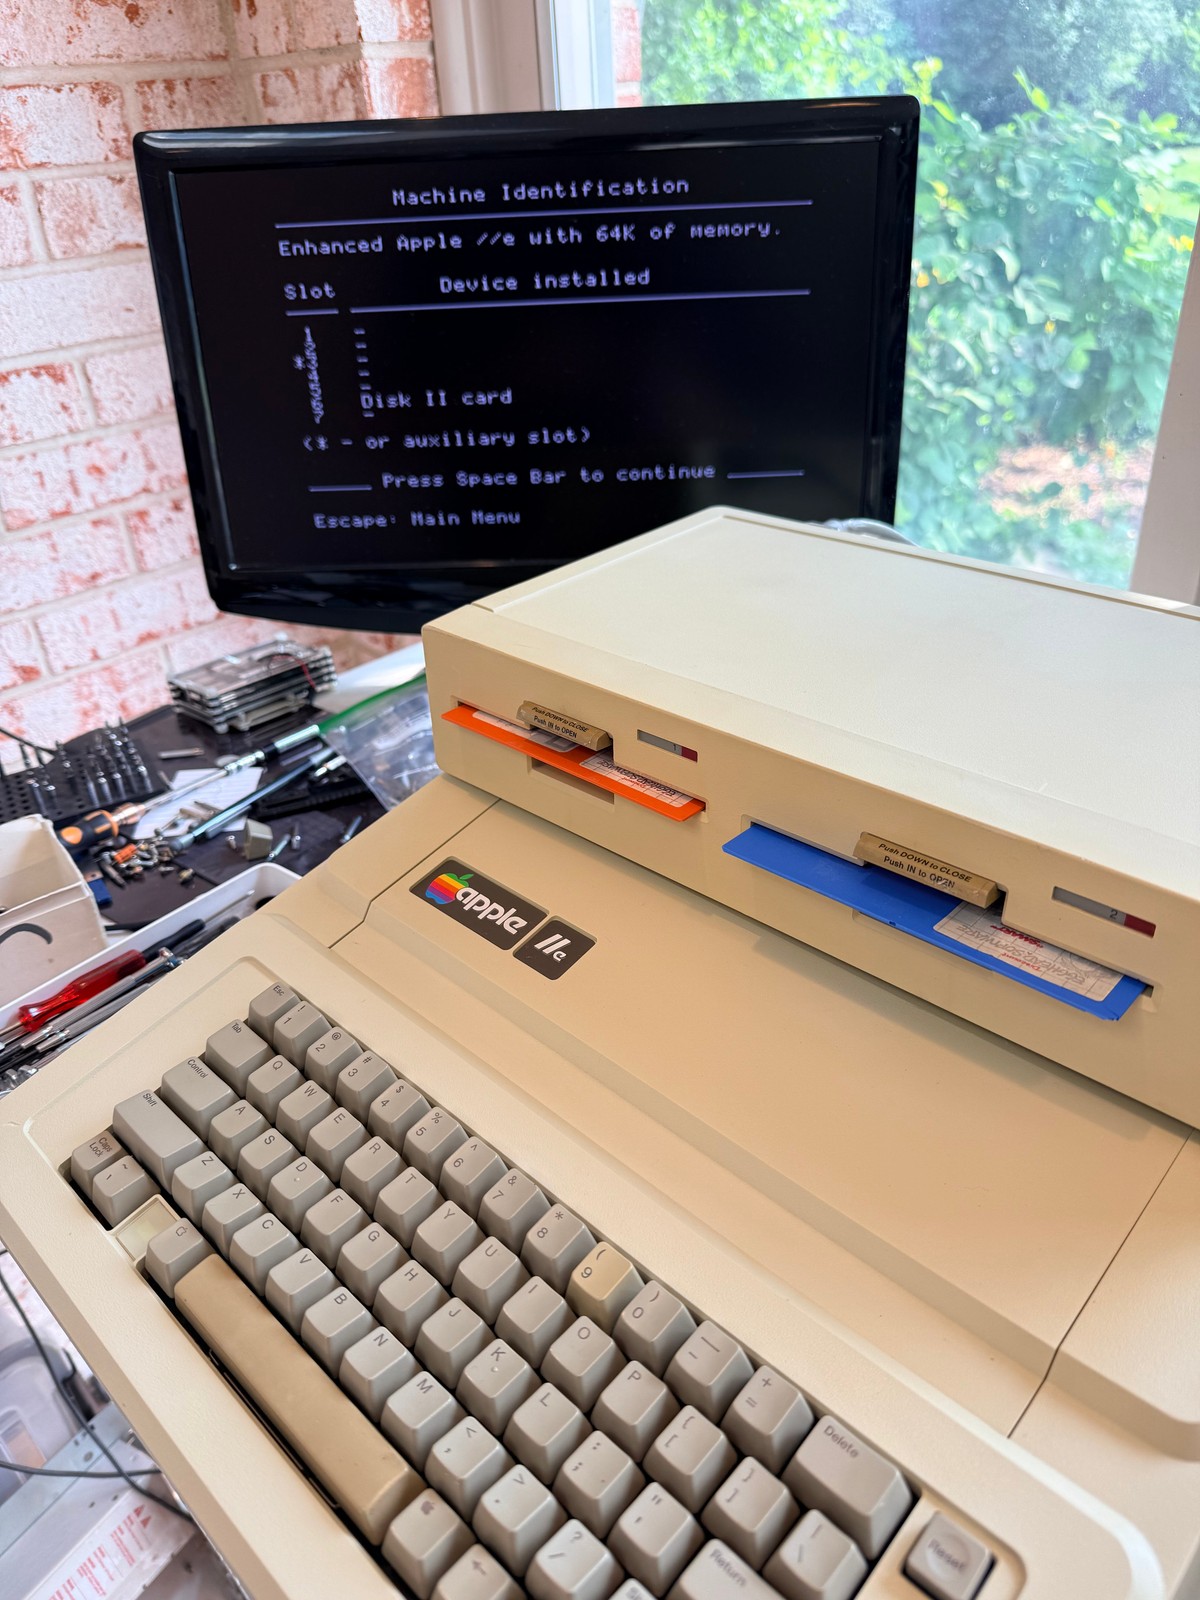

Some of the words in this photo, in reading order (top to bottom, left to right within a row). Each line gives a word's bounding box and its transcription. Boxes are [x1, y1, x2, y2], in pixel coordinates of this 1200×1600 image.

[391, 186, 485, 206] Machine
[502, 177, 690, 201] Identification
[278, 235, 383, 256] Enhanced
[396, 232, 462, 252] Apple
[476, 231, 516, 246] //e
[529, 227, 582, 245] with
[596, 223, 636, 242] 64K
[650, 221, 676, 240] of
[690, 222, 781, 239] memory.
[439, 274, 518, 293] Device
[534, 267, 651, 289] installed
[284, 282, 336, 300] Slot
[360, 390, 412, 409] Disk
[426, 389, 447, 407] II
[461, 387, 513, 405] card
[365, 436, 390, 449] or
[403, 429, 516, 448] auxiliary
[527, 426, 591, 444] slot)
[381, 472, 444, 488] Press
[456, 470, 518, 487] Space
[529, 468, 567, 484] Bar
[580, 466, 604, 483] to
[616, 463, 716, 482] continue
[313, 513, 397, 529] Escape:
[410, 510, 460, 526] Main
[471, 509, 521, 525] Menu
[532, 706, 545, 716] Push
[545, 711, 564, 722] DOWN
[568, 721, 590, 733] CLOSE
[533, 715, 547, 726] Push
[547, 721, 554, 729] IN
[561, 727, 578, 739] OPEN
[879, 843, 899, 855] Push
[900, 851, 930, 866] DOWN
[930, 862, 939, 870] to
[939, 866, 973, 882] CLOSE
[883, 855, 904, 869] Push
[906, 864, 916, 874] IN
[918, 869, 927, 878] to
[455, 887, 528, 935] apple
[1108, 908, 1118, 920] 2
[273, 985, 285, 997] Esc
[297, 1004, 306, 1012] !
[283, 1017, 292, 1025] 1
[231, 1023, 242, 1033] Tab
[331, 1032, 342, 1041] @
[315, 1043, 326, 1053] 2
[272, 1061, 283, 1071] Q
[362, 1056, 373, 1064] #
[187, 1058, 208, 1079] Control
[348, 1068, 358, 1078] 3
[304, 1085, 317, 1097] W
[395, 1085, 405, 1094] $
[142, 1093, 157, 1107] Shift
[380, 1099, 390, 1108] 4
[235, 1106, 246, 1116] A
[333, 1113, 346, 1124] E
[431, 1112, 443, 1124] %
[415, 1126, 427, 1137] 5
[98, 1137, 113, 1152] Caps
[264, 1135, 275, 1145] S
[89, 1141, 104, 1157] Lock
[369, 1143, 381, 1154] R
[201, 1156, 214, 1166] Z
[295, 1162, 307, 1172] D
[453, 1157, 464, 1168] 6
[405, 1173, 417, 1184] T
[507, 1175, 517, 1187] &
[232, 1188, 246, 1199] X
[330, 1194, 343, 1205] F
[492, 1190, 504, 1200] 7
[443, 1208, 456, 1220] Y
[262, 1219, 274, 1230] C
[368, 1230, 380, 1242] G
[536, 1227, 549, 1239] 8
[485, 1244, 498, 1257] U
[596, 1249, 606, 1260] (
[299, 1254, 312, 1264] V
[404, 1268, 419, 1281] H
[580, 1266, 593, 1279] 9
[334, 1293, 347, 1305] B
[649, 1290, 660, 1303] )
[448, 1309, 462, 1318] J
[577, 1326, 591, 1340] O
[372, 1333, 389, 1347] N
[490, 1346, 506, 1362] K
[627, 1370, 641, 1381] P
[416, 1378, 434, 1394] M
[762, 1377, 772, 1388] +
[540, 1392, 551, 1407] L
[745, 1397, 757, 1408] =
[823, 1425, 859, 1458] Delete
